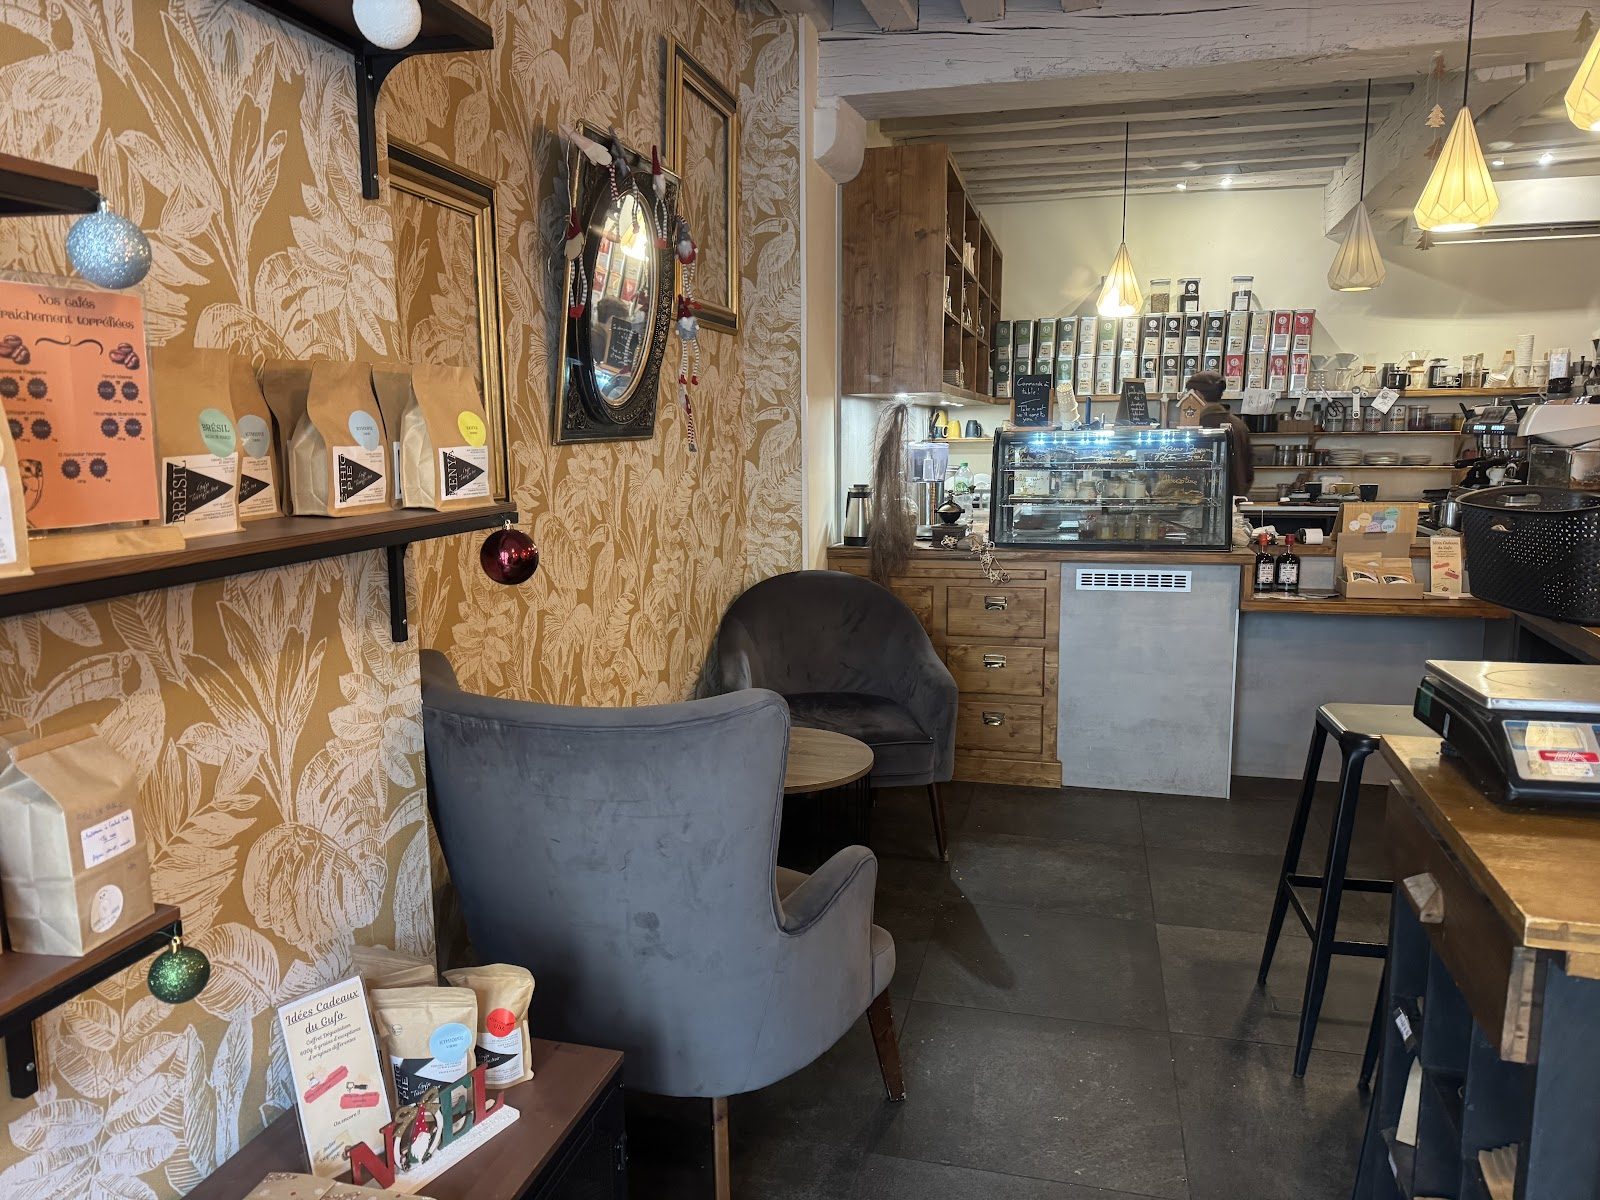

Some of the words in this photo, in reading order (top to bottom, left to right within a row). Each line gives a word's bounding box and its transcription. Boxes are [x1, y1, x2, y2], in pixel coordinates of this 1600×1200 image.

[38, 294, 61, 306] Nos
[201, 422, 230, 433] BRÉSIL
[447, 450, 459, 496] KENYA
[169, 460, 188, 524] BRÉSIL
[285, 1008, 313, 1026] Idées
[316, 990, 360, 1012] Cadeaux
[305, 1022, 319, 1035] du
[320, 1010, 344, 1027] Gufo
